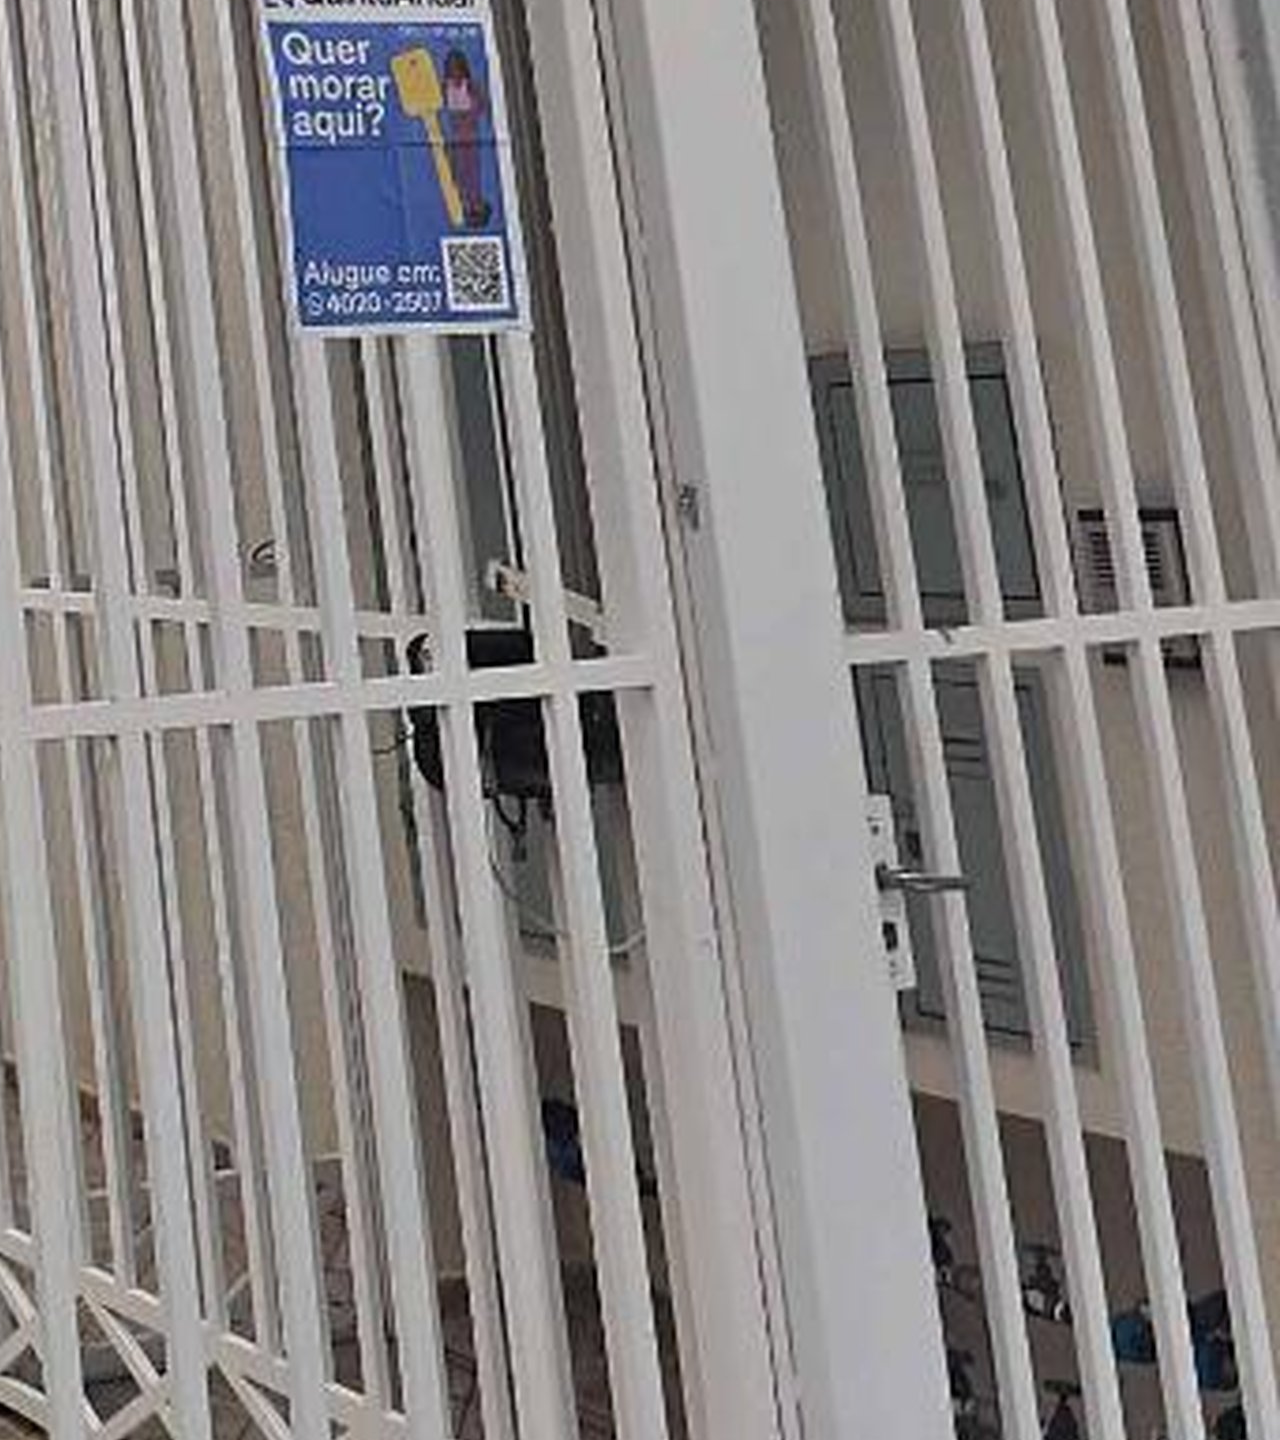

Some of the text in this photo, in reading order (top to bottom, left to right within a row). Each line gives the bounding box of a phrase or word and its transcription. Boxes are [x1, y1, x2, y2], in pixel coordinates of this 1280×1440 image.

[282, 31, 370, 65] Quer
[290, 74, 390, 100] morar
[293, 102, 385, 145] aqui?
[304, 261, 440, 290] Alugue em:
